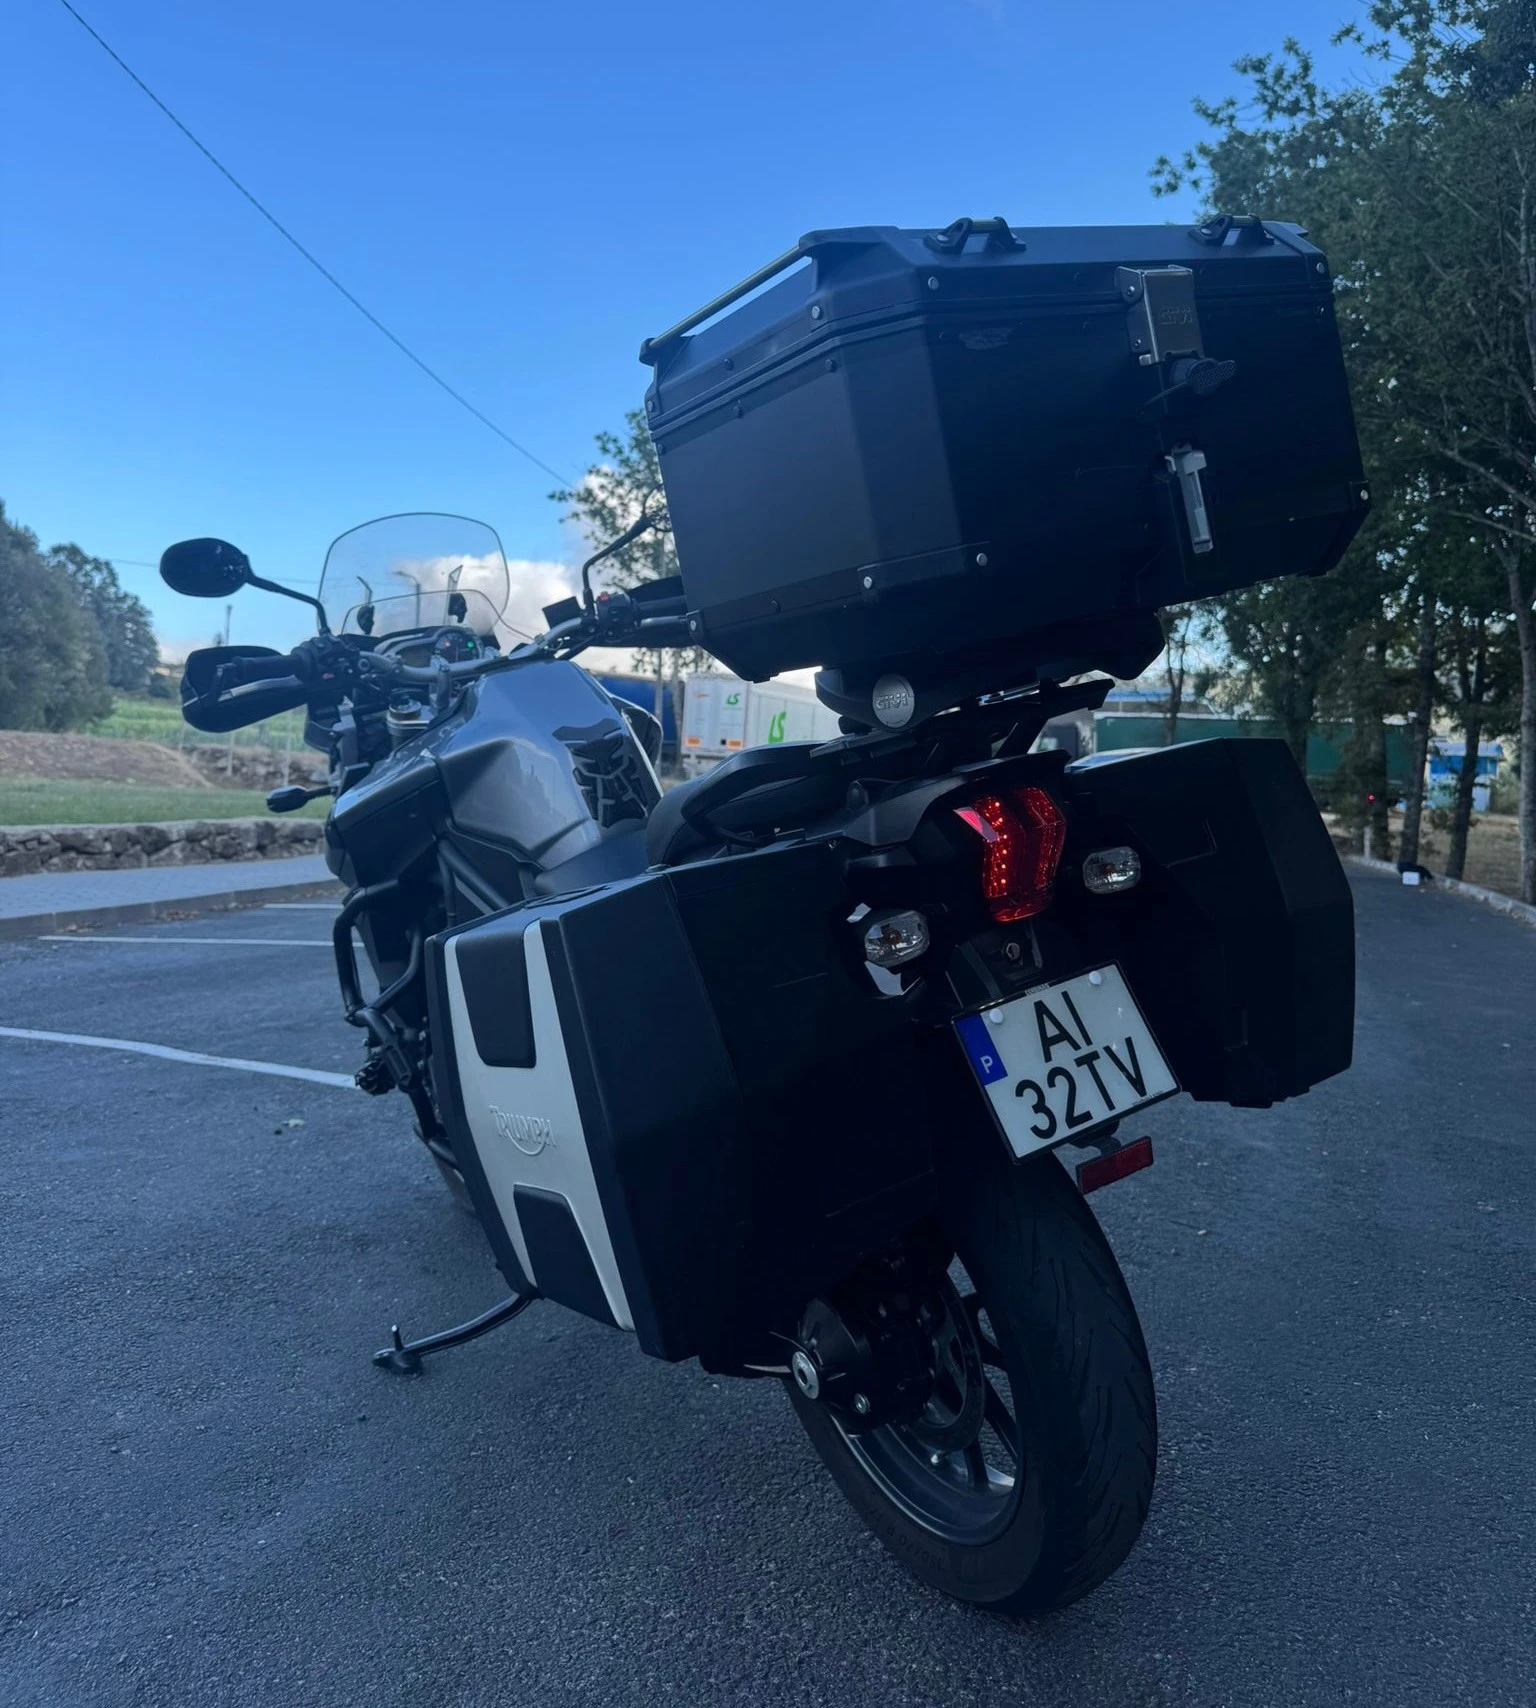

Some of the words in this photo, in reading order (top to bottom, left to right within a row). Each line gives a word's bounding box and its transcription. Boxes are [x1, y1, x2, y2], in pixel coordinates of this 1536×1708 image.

[768, 711, 787, 744] LS
[1033, 990, 1093, 1063] AI
[979, 1055, 994, 1074] P
[1015, 1036, 1148, 1140] 32TV
[489, 1104, 560, 1153] TRIUMPH
